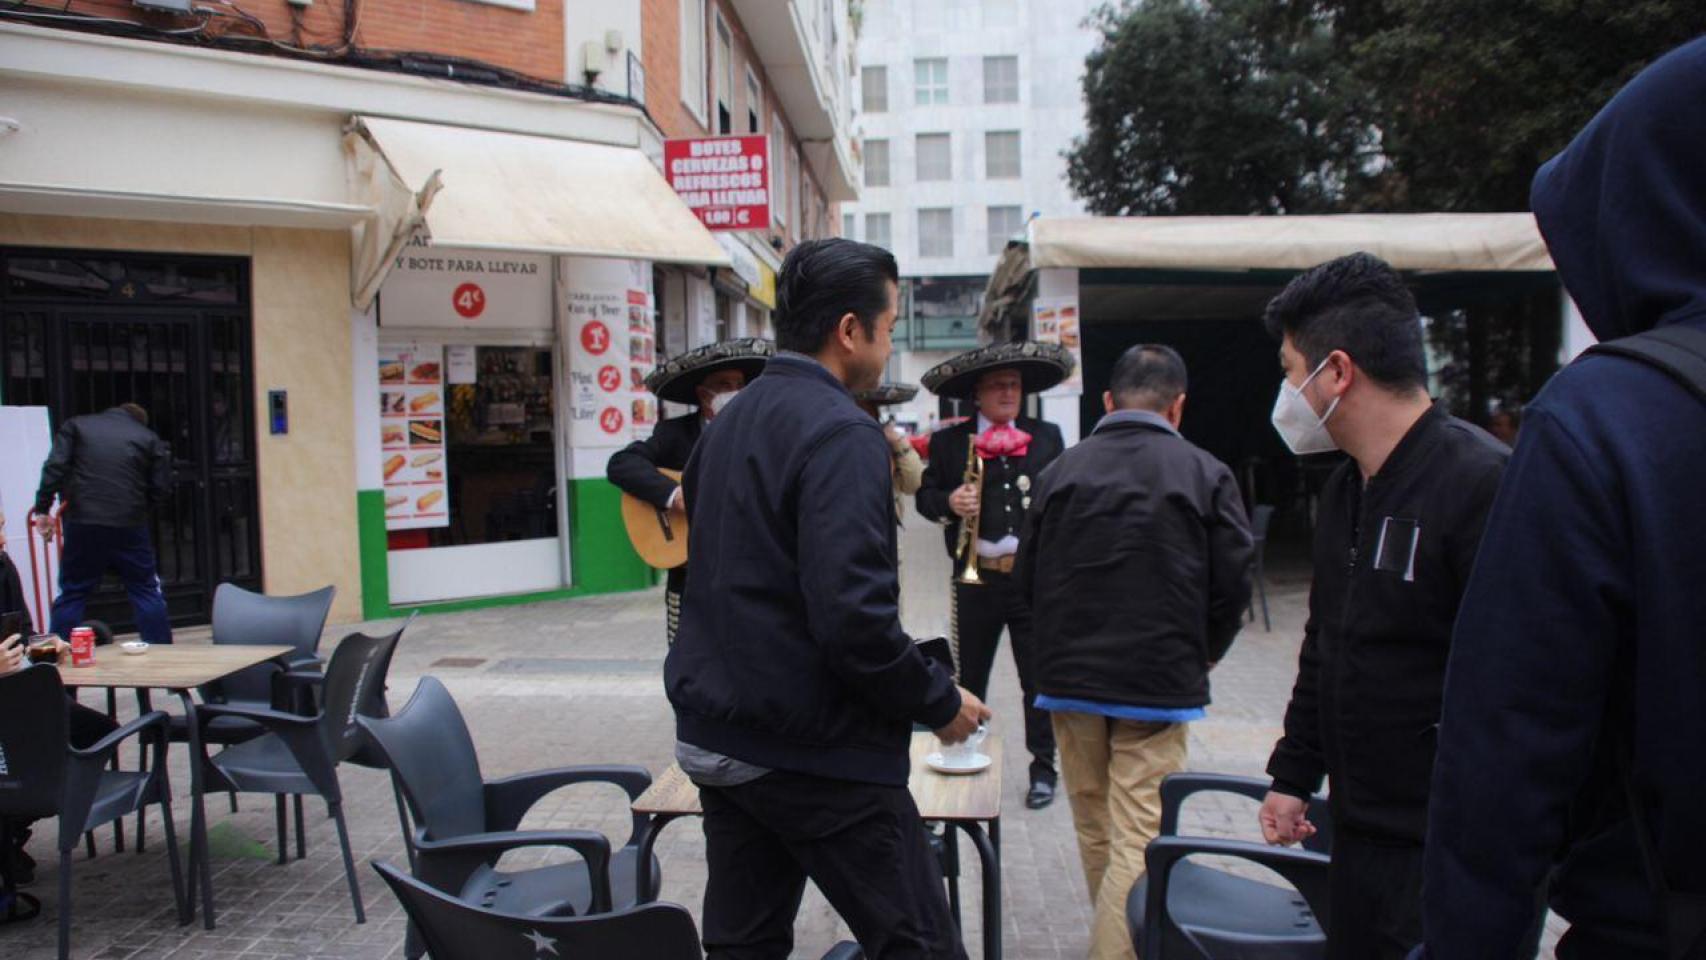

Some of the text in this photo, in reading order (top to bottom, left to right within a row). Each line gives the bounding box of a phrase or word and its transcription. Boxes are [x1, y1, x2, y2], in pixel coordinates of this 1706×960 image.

[690, 140, 741, 156] BOTES
[671, 154, 762, 174] CERVEZAS O
[712, 188, 767, 205] LLEVAR
[408, 258, 444, 271] BOTE
[447, 259, 485, 273] PARA
[488, 261, 538, 275] LLEVAR
